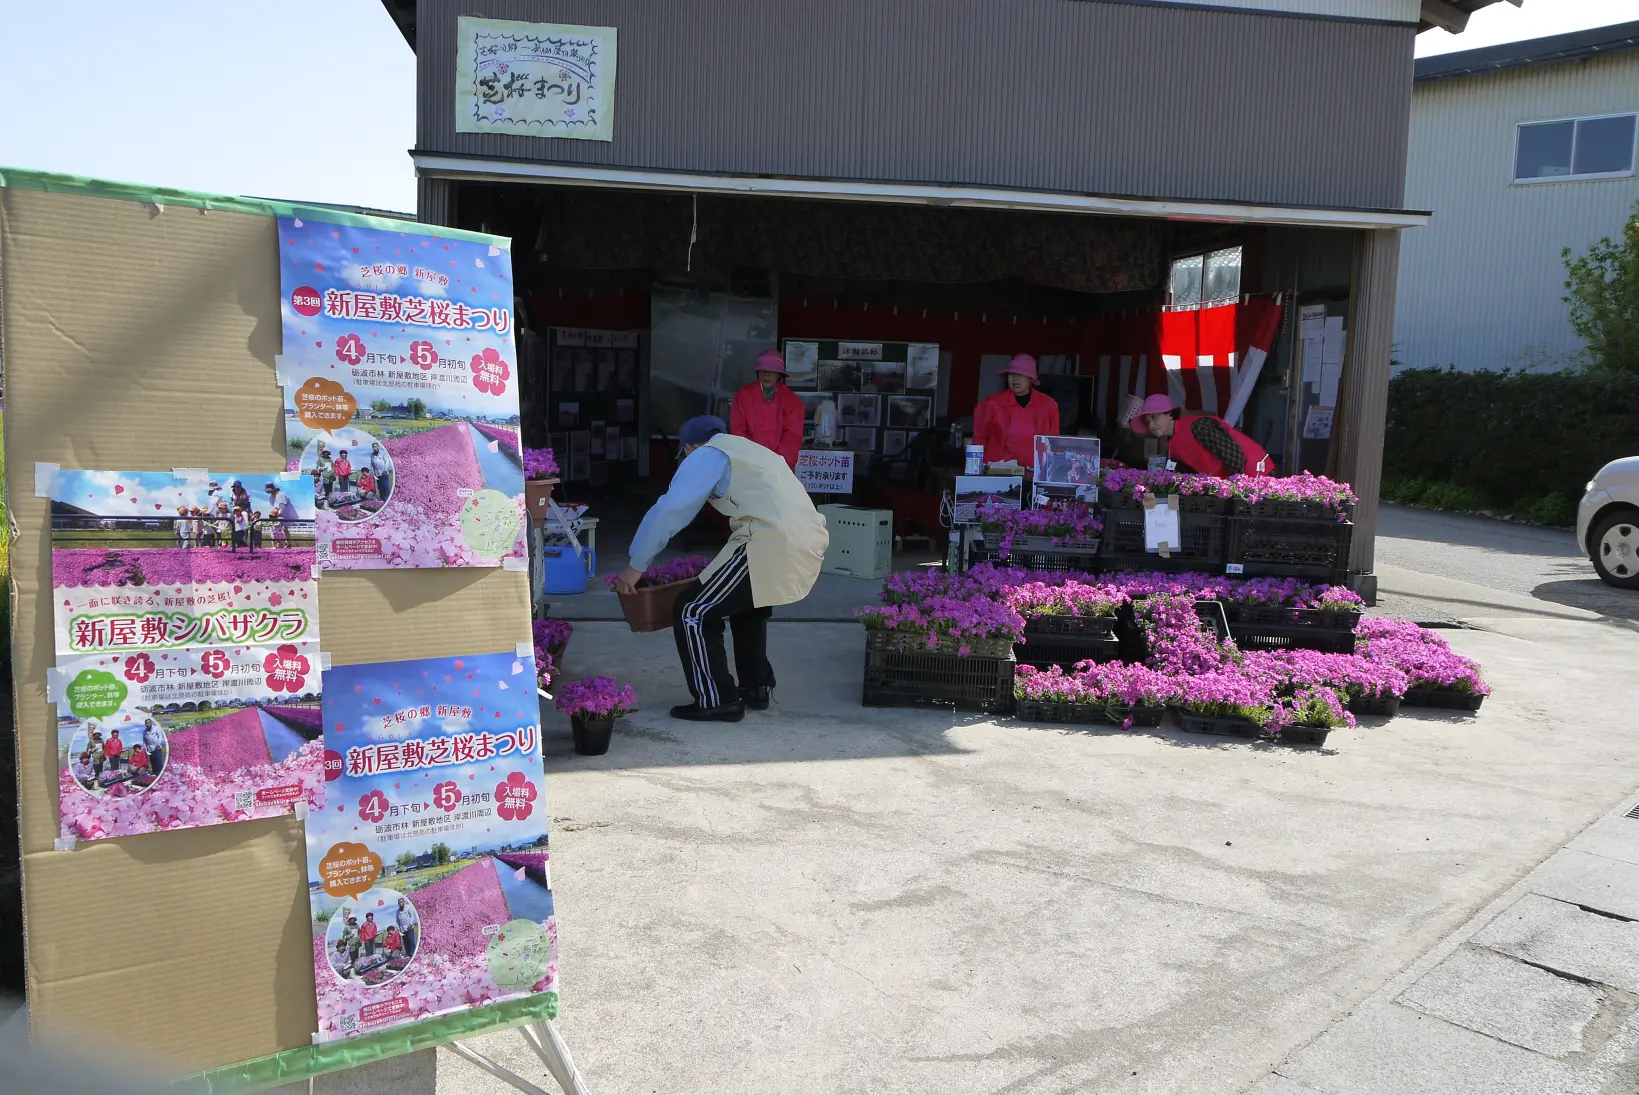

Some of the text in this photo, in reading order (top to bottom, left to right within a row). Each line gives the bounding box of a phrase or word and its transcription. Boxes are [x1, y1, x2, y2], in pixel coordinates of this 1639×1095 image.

[360, 263, 449, 286] 芝桜の郷 新屋敷
[293, 294, 321, 307] 第3回
[326, 289, 508, 333] 新屋敷芝桜まつり
[478, 359, 503, 376] 入場料
[388, 370, 428, 381] 新屋敷地区
[479, 370, 500, 386] 無料
[799, 454, 851, 468] 芝桜ポット苗
[800, 470, 848, 481] ご予約承ります
[75, 612, 303, 648] 新屋敷シバザクラ
[272, 658, 302, 672] 入場料
[273, 669, 298, 683] 無料
[177, 680, 219, 691] 新屋敷地区
[382, 705, 472, 729] 芝桜の郷 新屋敷
[348, 727, 533, 775] 新屋敷芝桜まつり
[503, 786, 530, 798] 入場料
[504, 797, 526, 810] 無料
[375, 821, 409, 834] 砺波市林
[412, 814, 451, 827] 新屋敷地区
